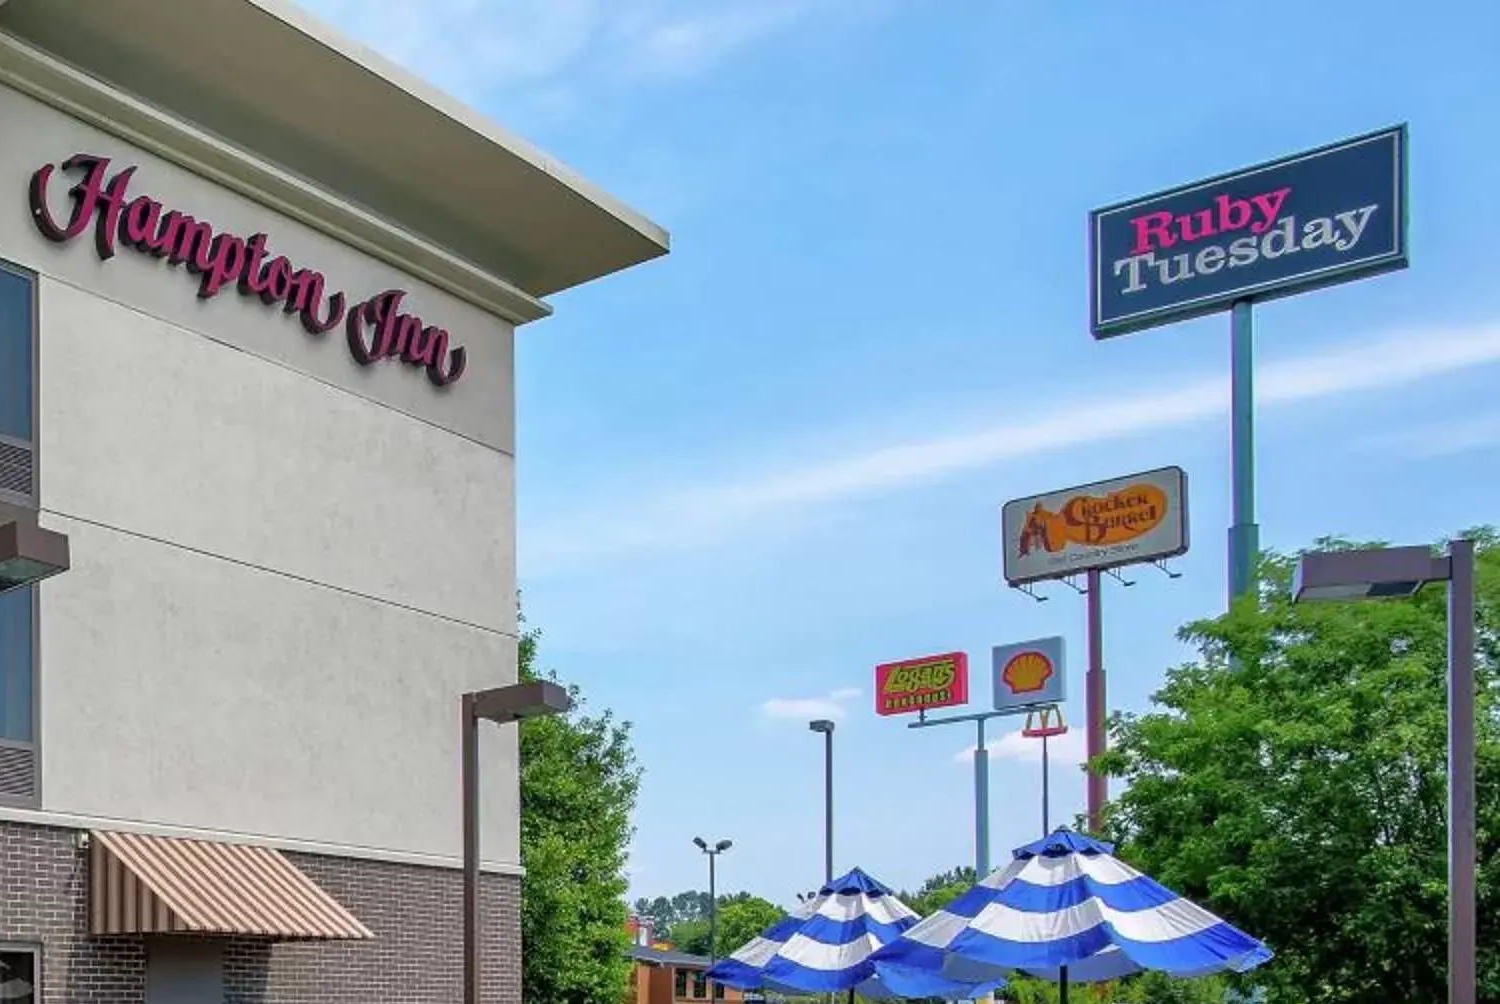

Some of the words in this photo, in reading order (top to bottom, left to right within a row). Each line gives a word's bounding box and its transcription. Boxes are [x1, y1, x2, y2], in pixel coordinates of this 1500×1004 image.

[1113, 203, 1380, 295] Tuesday
[1129, 186, 1293, 255] Ruby
[29, 152, 345, 335] Hampton
[346, 289, 467, 387] Inn
